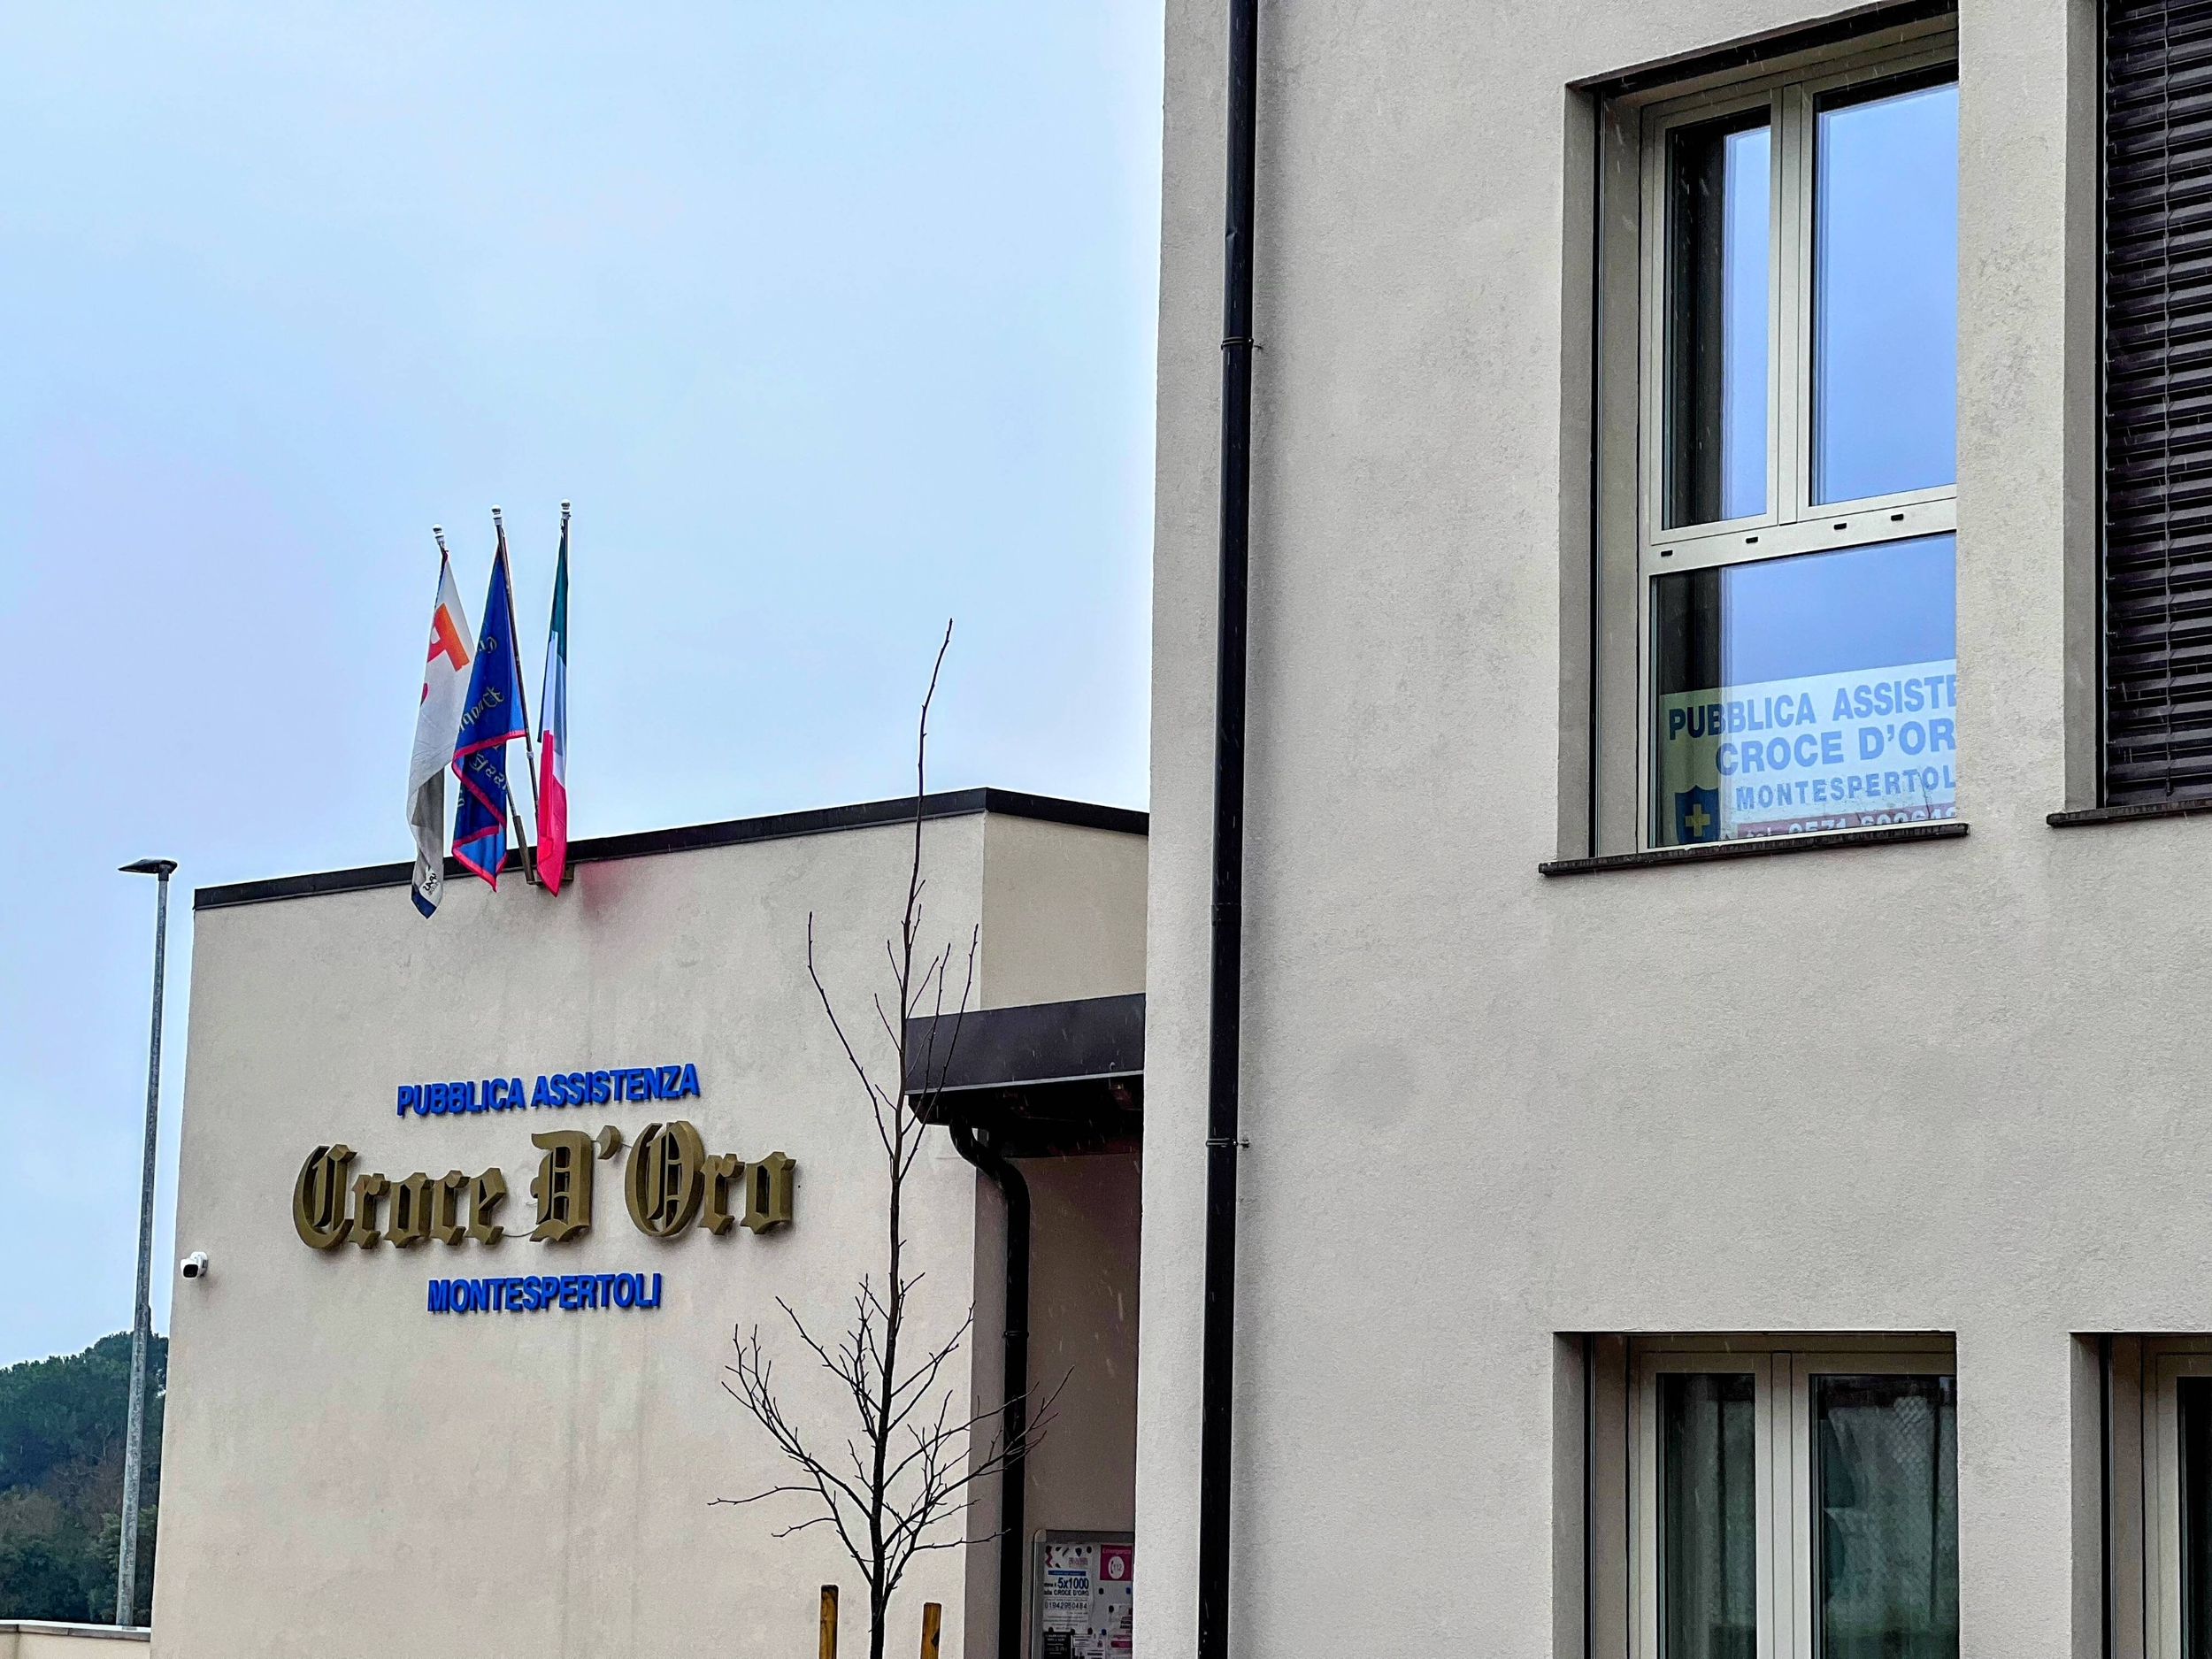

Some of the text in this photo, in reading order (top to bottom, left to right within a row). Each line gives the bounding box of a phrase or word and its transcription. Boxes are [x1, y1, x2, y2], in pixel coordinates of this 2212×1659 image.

[1669, 692, 1816, 741] PUBBLICA
[1716, 718, 1956, 776] CROCE D'OR
[1735, 765, 1956, 811] MONTESPERTOL
[396, 1064, 700, 1117] PUBBLICA ASSISTENZA
[293, 1120, 796, 1249] Croce D'Oro
[427, 1272, 661, 1313] MONTESPERTOLI
[1057, 1577, 1089, 1590] 5x1000
